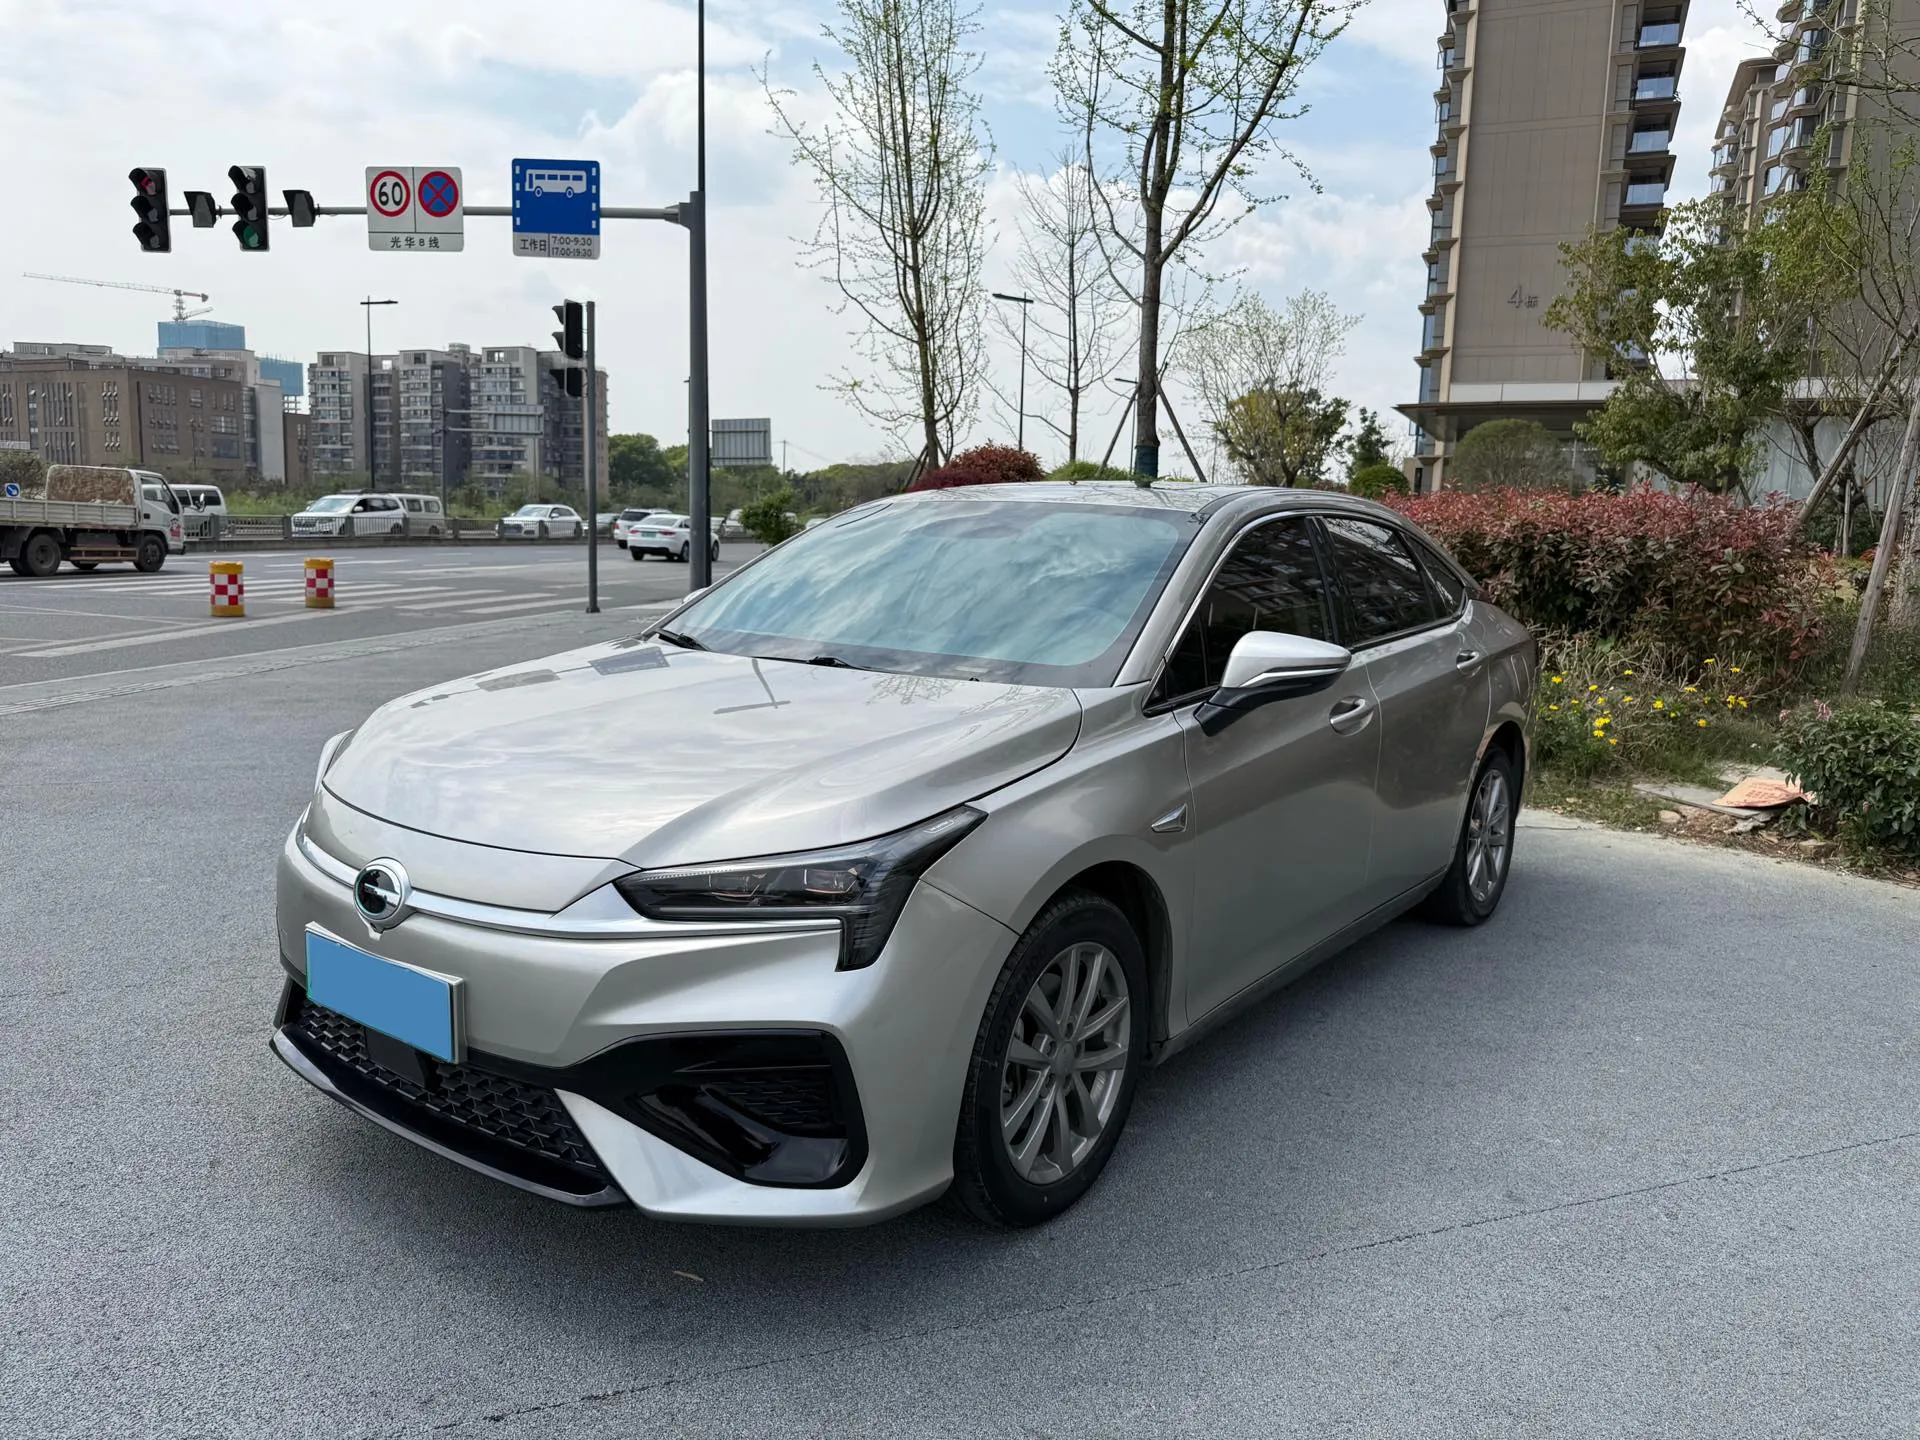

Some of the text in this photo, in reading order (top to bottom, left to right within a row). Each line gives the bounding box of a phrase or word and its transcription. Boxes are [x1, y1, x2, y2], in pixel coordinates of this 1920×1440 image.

[378, 181, 403, 207] 60
[390, 236, 440, 249] 光华8线
[520, 239, 547, 252] 工作日
[551, 235, 592, 247] 7:00-9:30
[551, 247, 592, 258] 17:00-19:30
